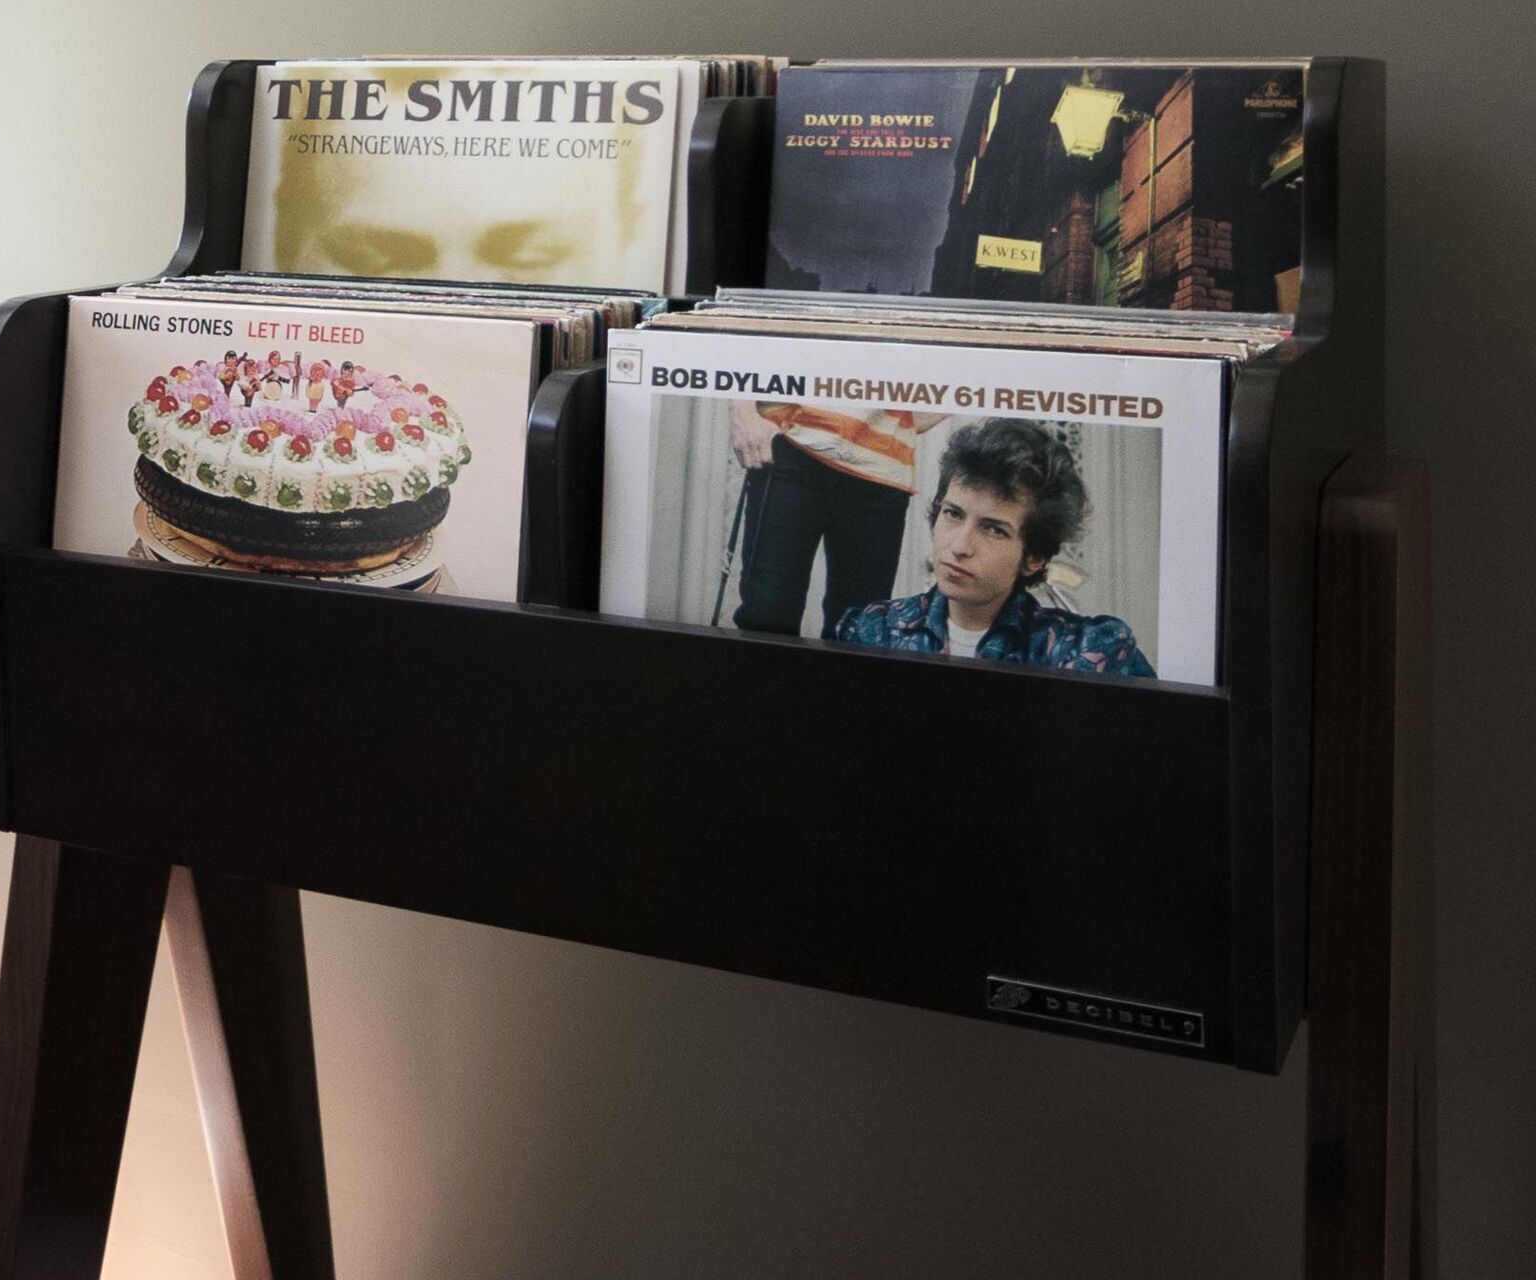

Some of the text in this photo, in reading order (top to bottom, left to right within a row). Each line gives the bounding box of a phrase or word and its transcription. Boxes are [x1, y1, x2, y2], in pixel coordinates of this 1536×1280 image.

[266, 79, 665, 126] THE SMITHS
[804, 114, 935, 127] DAVID BOWIE
[453, 136, 511, 158] HERE
[519, 137, 550, 158] WE
[786, 135, 953, 149] ZIGGY STARDUST
[91, 311, 365, 345] ROLLING STONES LET IT BLEED
[651, 366, 1164, 420] BOB DYLAN HIGHWAY 61 REVISITED
